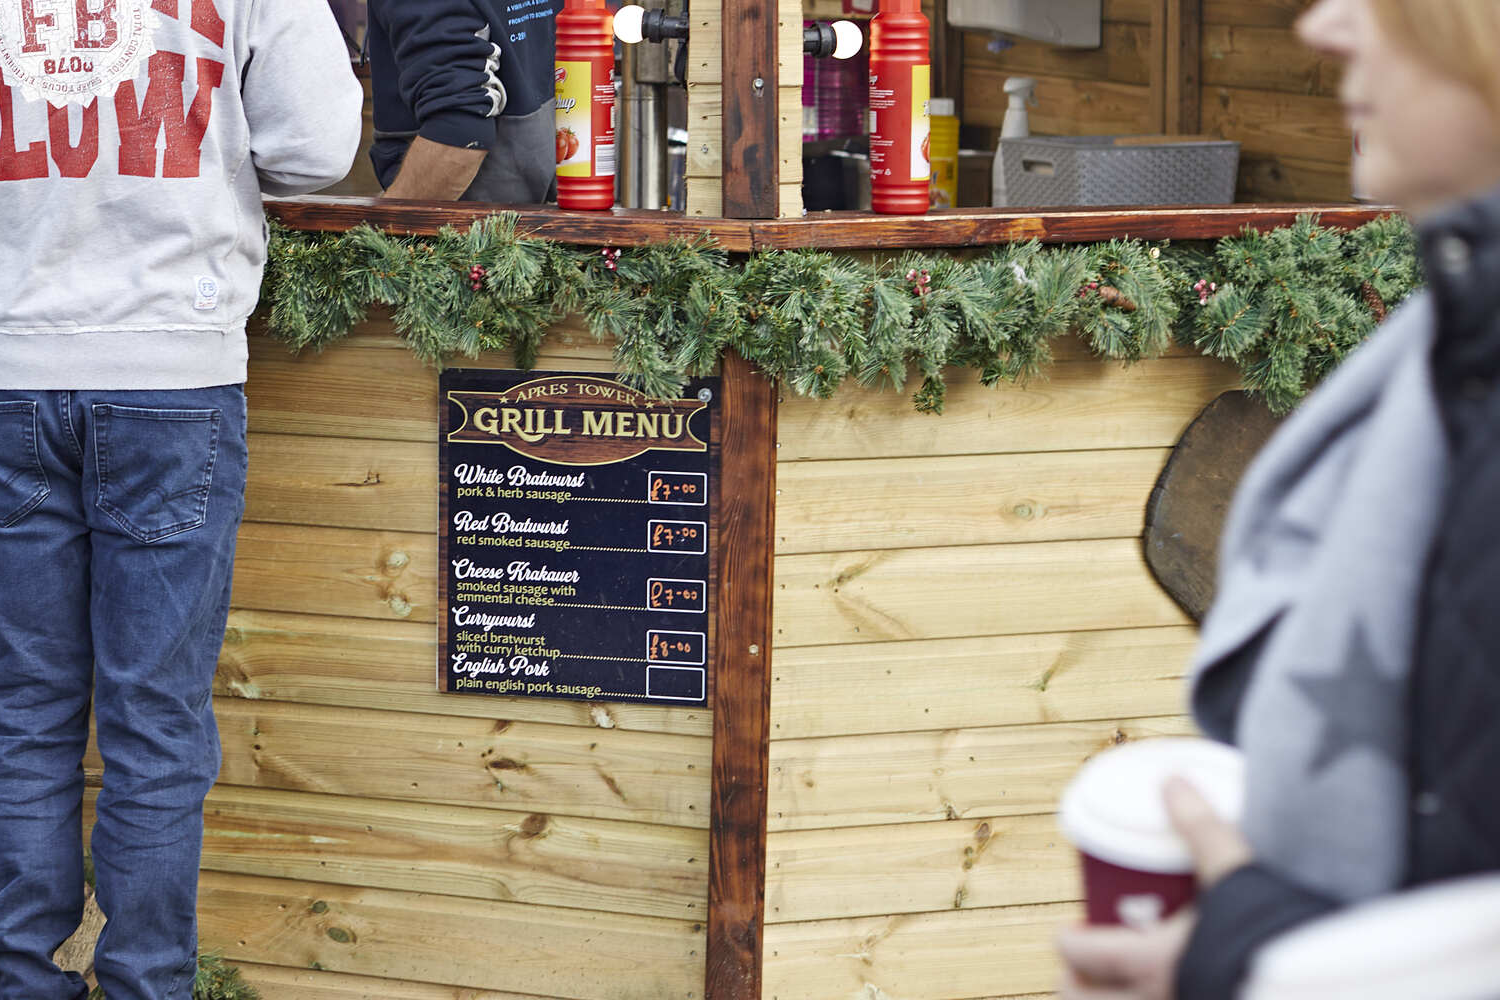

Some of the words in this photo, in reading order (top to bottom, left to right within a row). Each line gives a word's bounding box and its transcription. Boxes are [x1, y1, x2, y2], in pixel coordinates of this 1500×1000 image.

[43, 56, 94, 75] BLOW
[108, 39, 139, 75] CONTROL
[515, 383, 568, 403] APRES
[574, 383, 638, 406] TOWER
[473, 407, 571, 442] GRILL
[581, 410, 684, 438] MENU
[453, 464, 504, 485] White
[507, 465, 585, 488] Bratwurst
[457, 486, 484, 499] pork
[485, 487, 495, 497] &
[497, 487, 523, 499] herb
[453, 510, 490, 531] Red
[491, 512, 569, 534] Bratwurst
[456, 534, 476, 545] red
[478, 535, 523, 547] smoked
[452, 558, 504, 579] Cheese
[506, 560, 580, 583] Krakauer
[456, 580, 501, 592] smoked
[503, 584, 548, 597] sausage
[550, 585, 576, 596] with
[456, 592, 513, 604] emmental
[452, 605, 536, 631] Currywurst
[456, 630, 488, 643] sliced
[490, 632, 546, 646] bratwurst
[456, 642, 481, 653] with
[484, 645, 512, 658] curry
[451, 652, 507, 678] English
[509, 655, 550, 676] Pork
[456, 677, 483, 690] plain
[485, 680, 525, 693] english
[527, 682, 553, 694] pork
